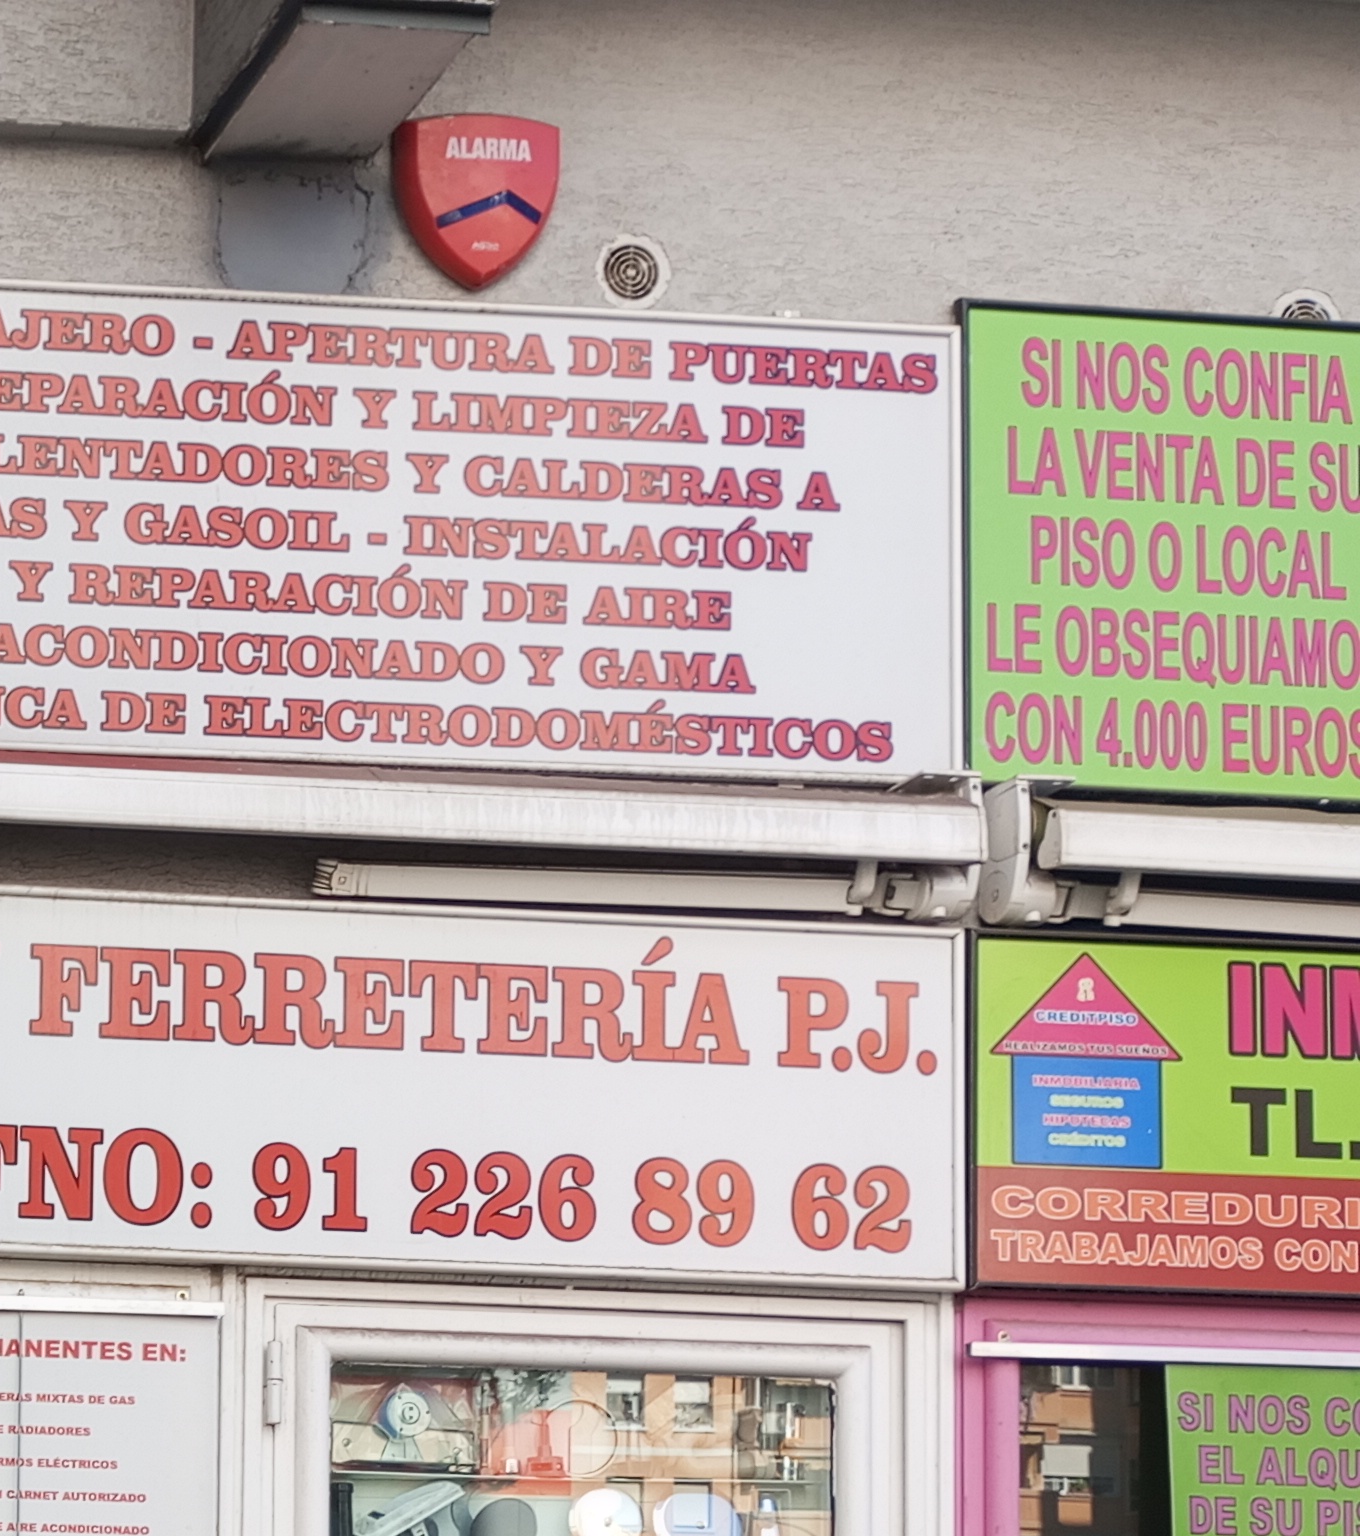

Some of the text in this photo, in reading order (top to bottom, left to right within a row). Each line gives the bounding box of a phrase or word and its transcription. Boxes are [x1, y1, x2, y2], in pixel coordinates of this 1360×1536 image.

[445, 136, 532, 162] ALARMA
[227, 322, 554, 373] APERTURA
[570, 337, 651, 378] DE
[670, 342, 937, 393] PUERTAS
[1022, 338, 1352, 423] SI NOS CONFIA
[354, 390, 395, 428] Y
[414, 392, 708, 443] LIMPIEZA
[722, 406, 805, 447] DE
[408, 454, 448, 493] Y
[465, 457, 783, 509] CALDERAS
[797, 472, 840, 511] A
[1008, 428, 1360, 513] LA VENTA DE SU
[65, 501, 107, 540] Y
[125, 503, 349, 551] GASOIL
[405, 517, 812, 571] INSTALACIÓN
[1031, 516, 1347, 600] PISO O LOCAL
[10, 561, 731, 630] Y REPARACIÓN DE AIRE
[988, 605, 1041, 673] LE
[522, 646, 563, 685] Y
[582, 649, 756, 694] GAMA
[102, 692, 186, 733] DE
[204, 696, 893, 762] ELECTRODOMÉSTICOS
[986, 692, 1082, 764] CON
[1096, 700, 1207, 770] 4.000
[30, 938, 749, 1065] FERRETERÍA
[778, 977, 937, 1075] P.J.
[1034, 1010, 1138, 1026] CREDITPISO
[1033, 1074, 1141, 1090] INMOBILIARIA
[253, 1142, 368, 1231] 91
[411, 1149, 596, 1241] 226
[632, 1158, 754, 1247] 89
[792, 1164, 911, 1253] 62
[991, 1230, 1360, 1273] TRABAJAMOS CON
[141, 1342, 186, 1362] EN:
[8, 1424, 92, 1437] RADIADORES
[1178, 1392, 1310, 1434] SI NOS
[1199, 1445, 1244, 1484] EL
[1189, 1496, 1237, 1536] DE
